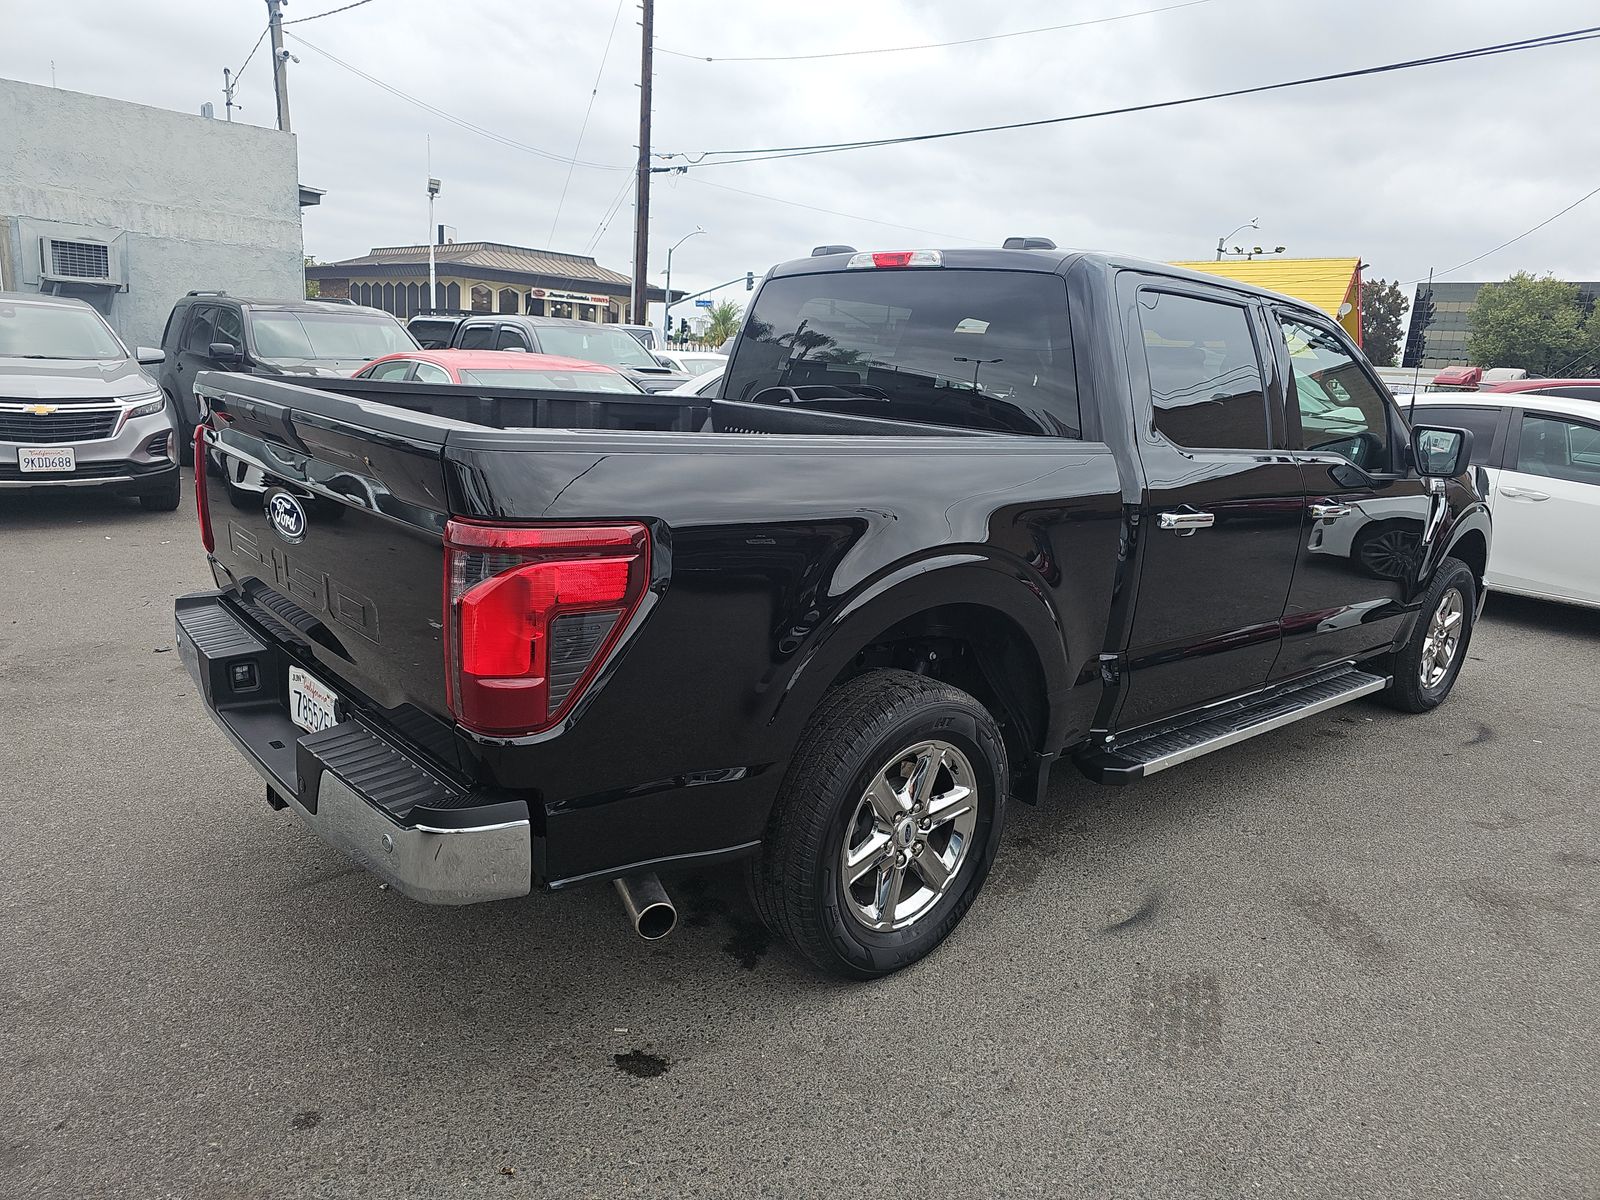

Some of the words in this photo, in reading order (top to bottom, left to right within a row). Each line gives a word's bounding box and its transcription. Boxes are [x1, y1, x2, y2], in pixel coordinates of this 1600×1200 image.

[23, 457, 72, 469] 9KDD688
[274, 498, 298, 532] Ford
[303, 676, 328, 703] California
